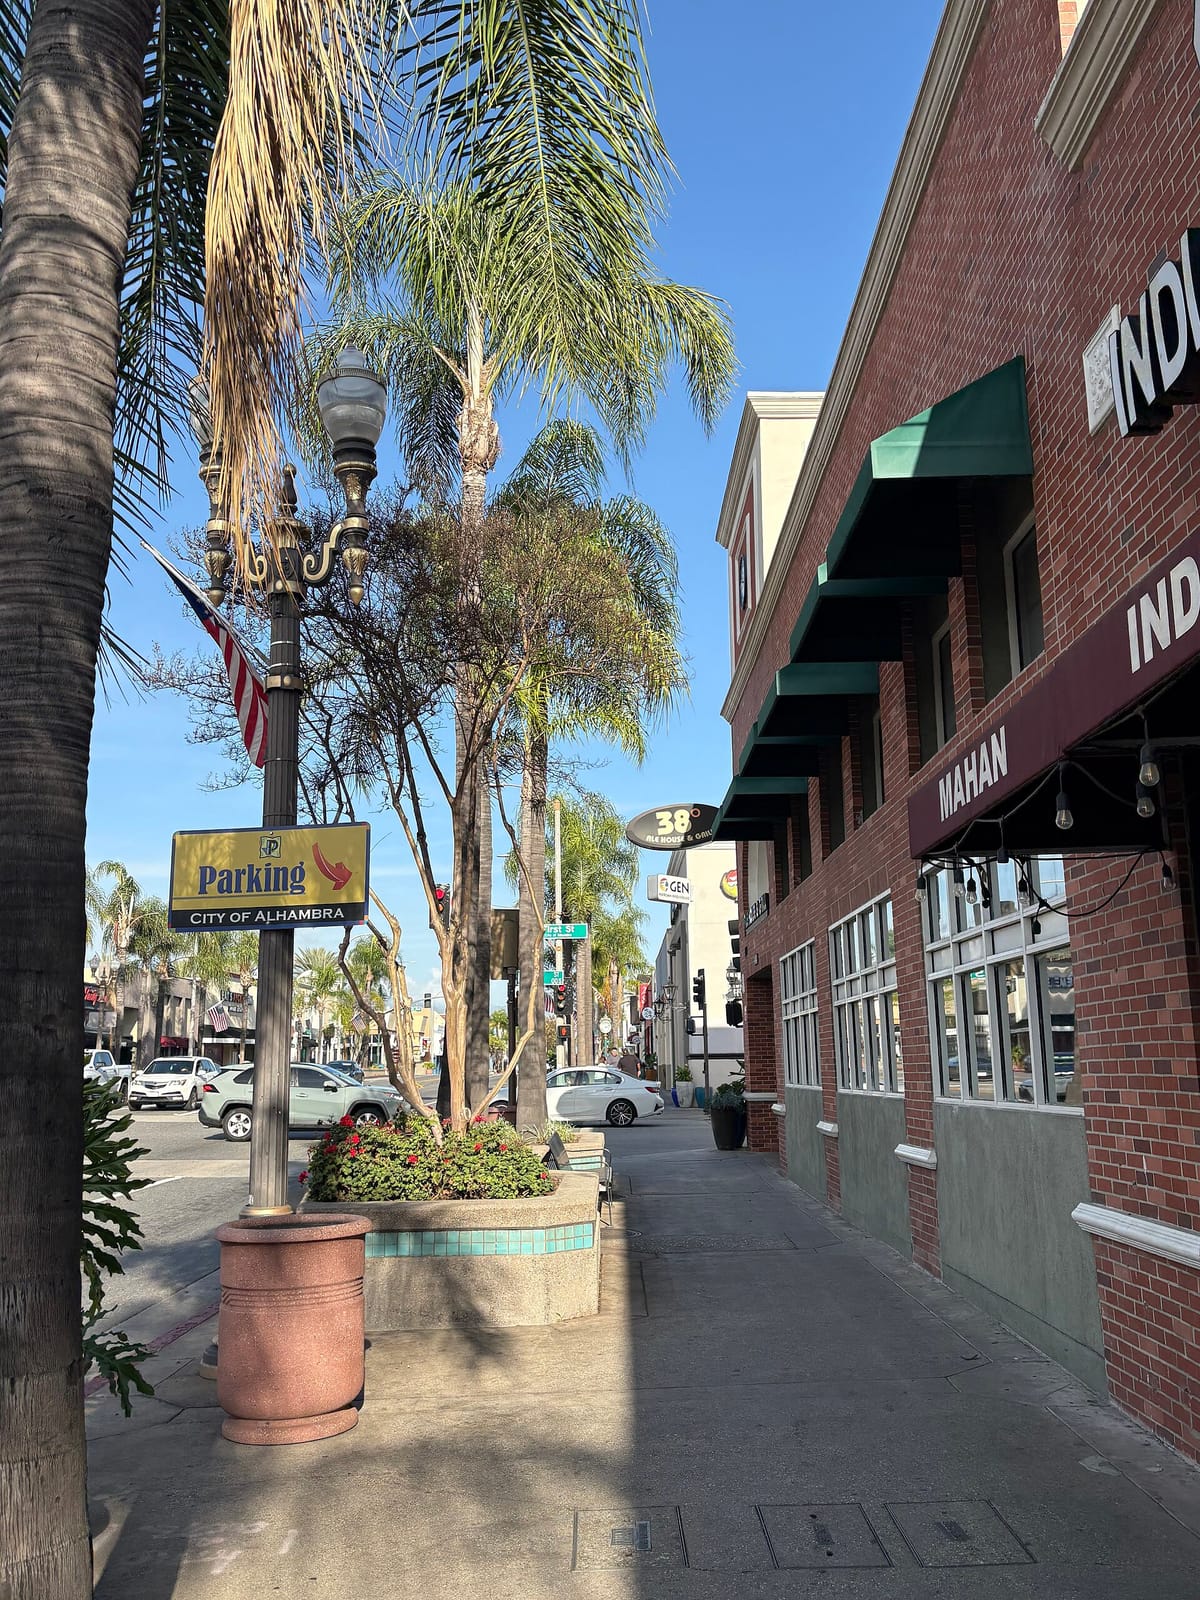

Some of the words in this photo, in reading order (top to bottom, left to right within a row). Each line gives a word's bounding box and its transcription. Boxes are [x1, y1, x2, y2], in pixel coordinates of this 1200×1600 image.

[938, 725, 1008, 823] MAHAN
[660, 835, 685, 844] HOUSE
[198, 861, 306, 895] Parking
[669, 880, 690, 894] GEN
[190, 912, 226, 925] CITY
[230, 911, 251, 923] OF
[254, 907, 345, 924] ALHAMBRA
[565, 925, 575, 933] St
